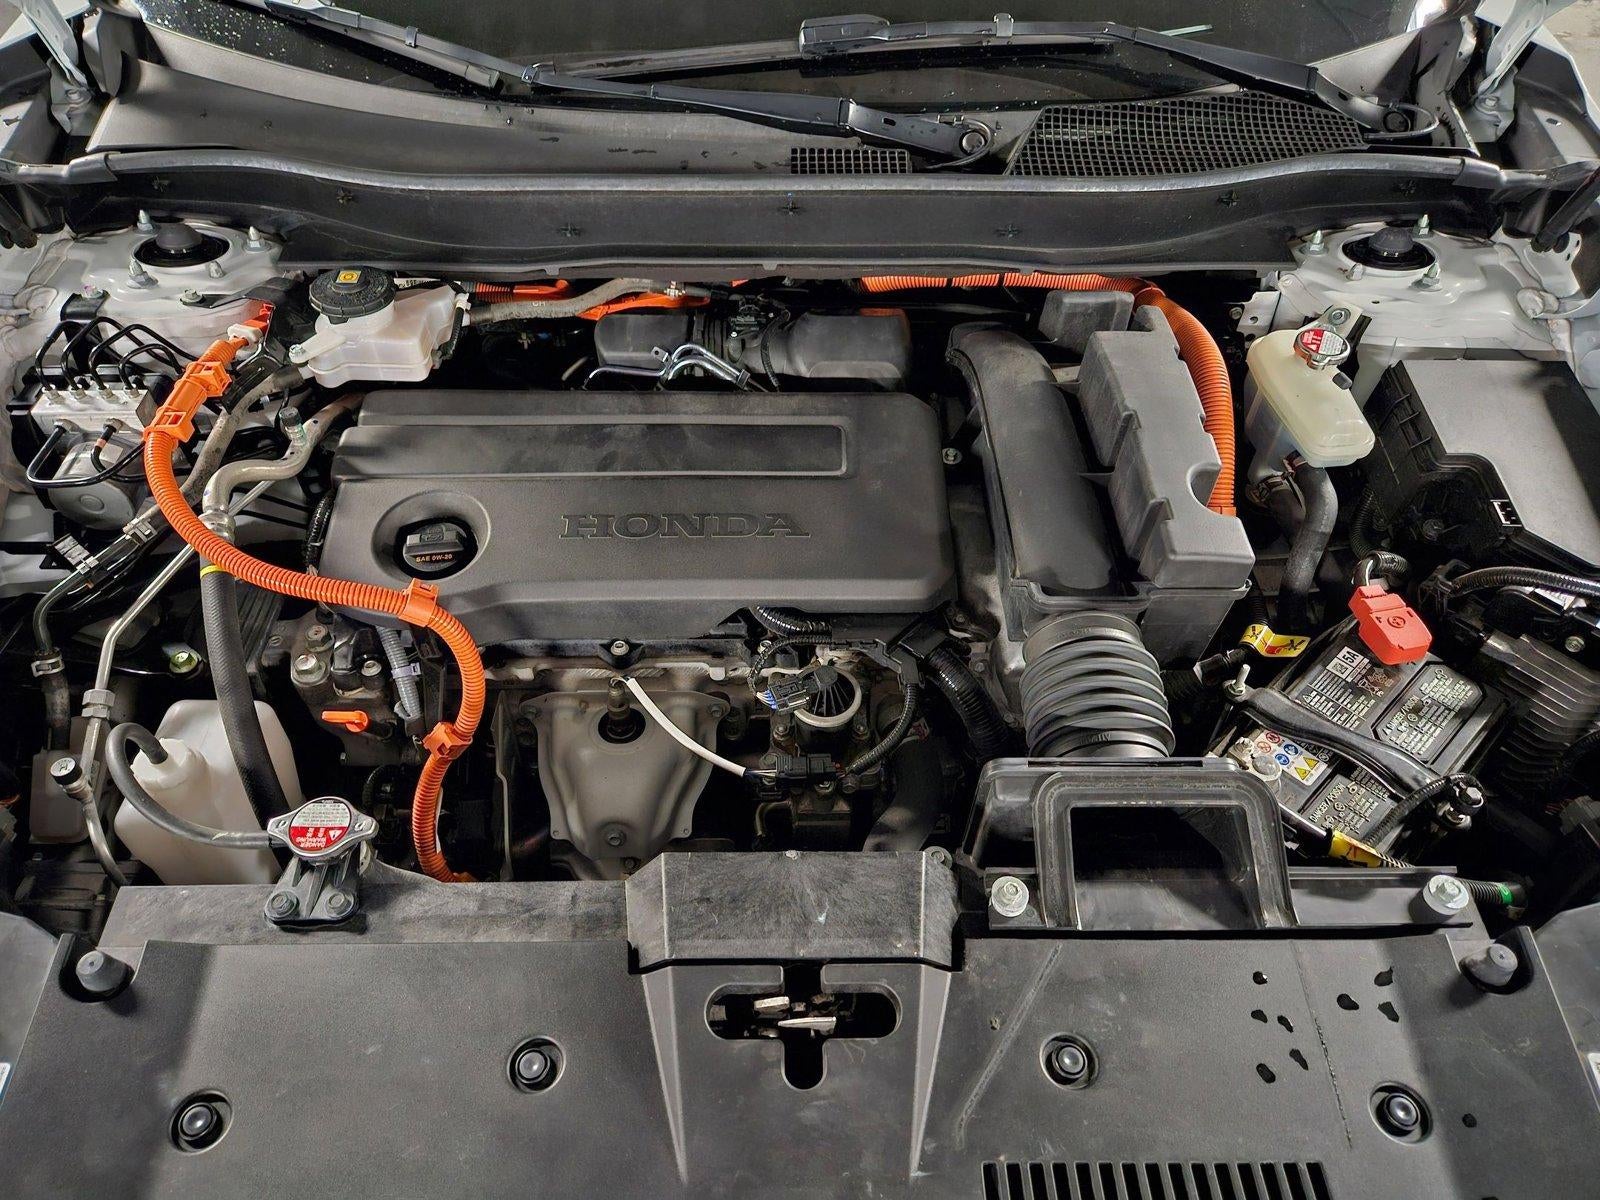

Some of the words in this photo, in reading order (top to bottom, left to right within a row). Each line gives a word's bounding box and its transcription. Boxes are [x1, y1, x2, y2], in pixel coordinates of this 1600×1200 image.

[558, 513, 811, 538] HONDA
[415, 555, 430, 563] SAE
[432, 553, 453, 561] 0W-20
[1342, 650, 1359, 663] 5A
